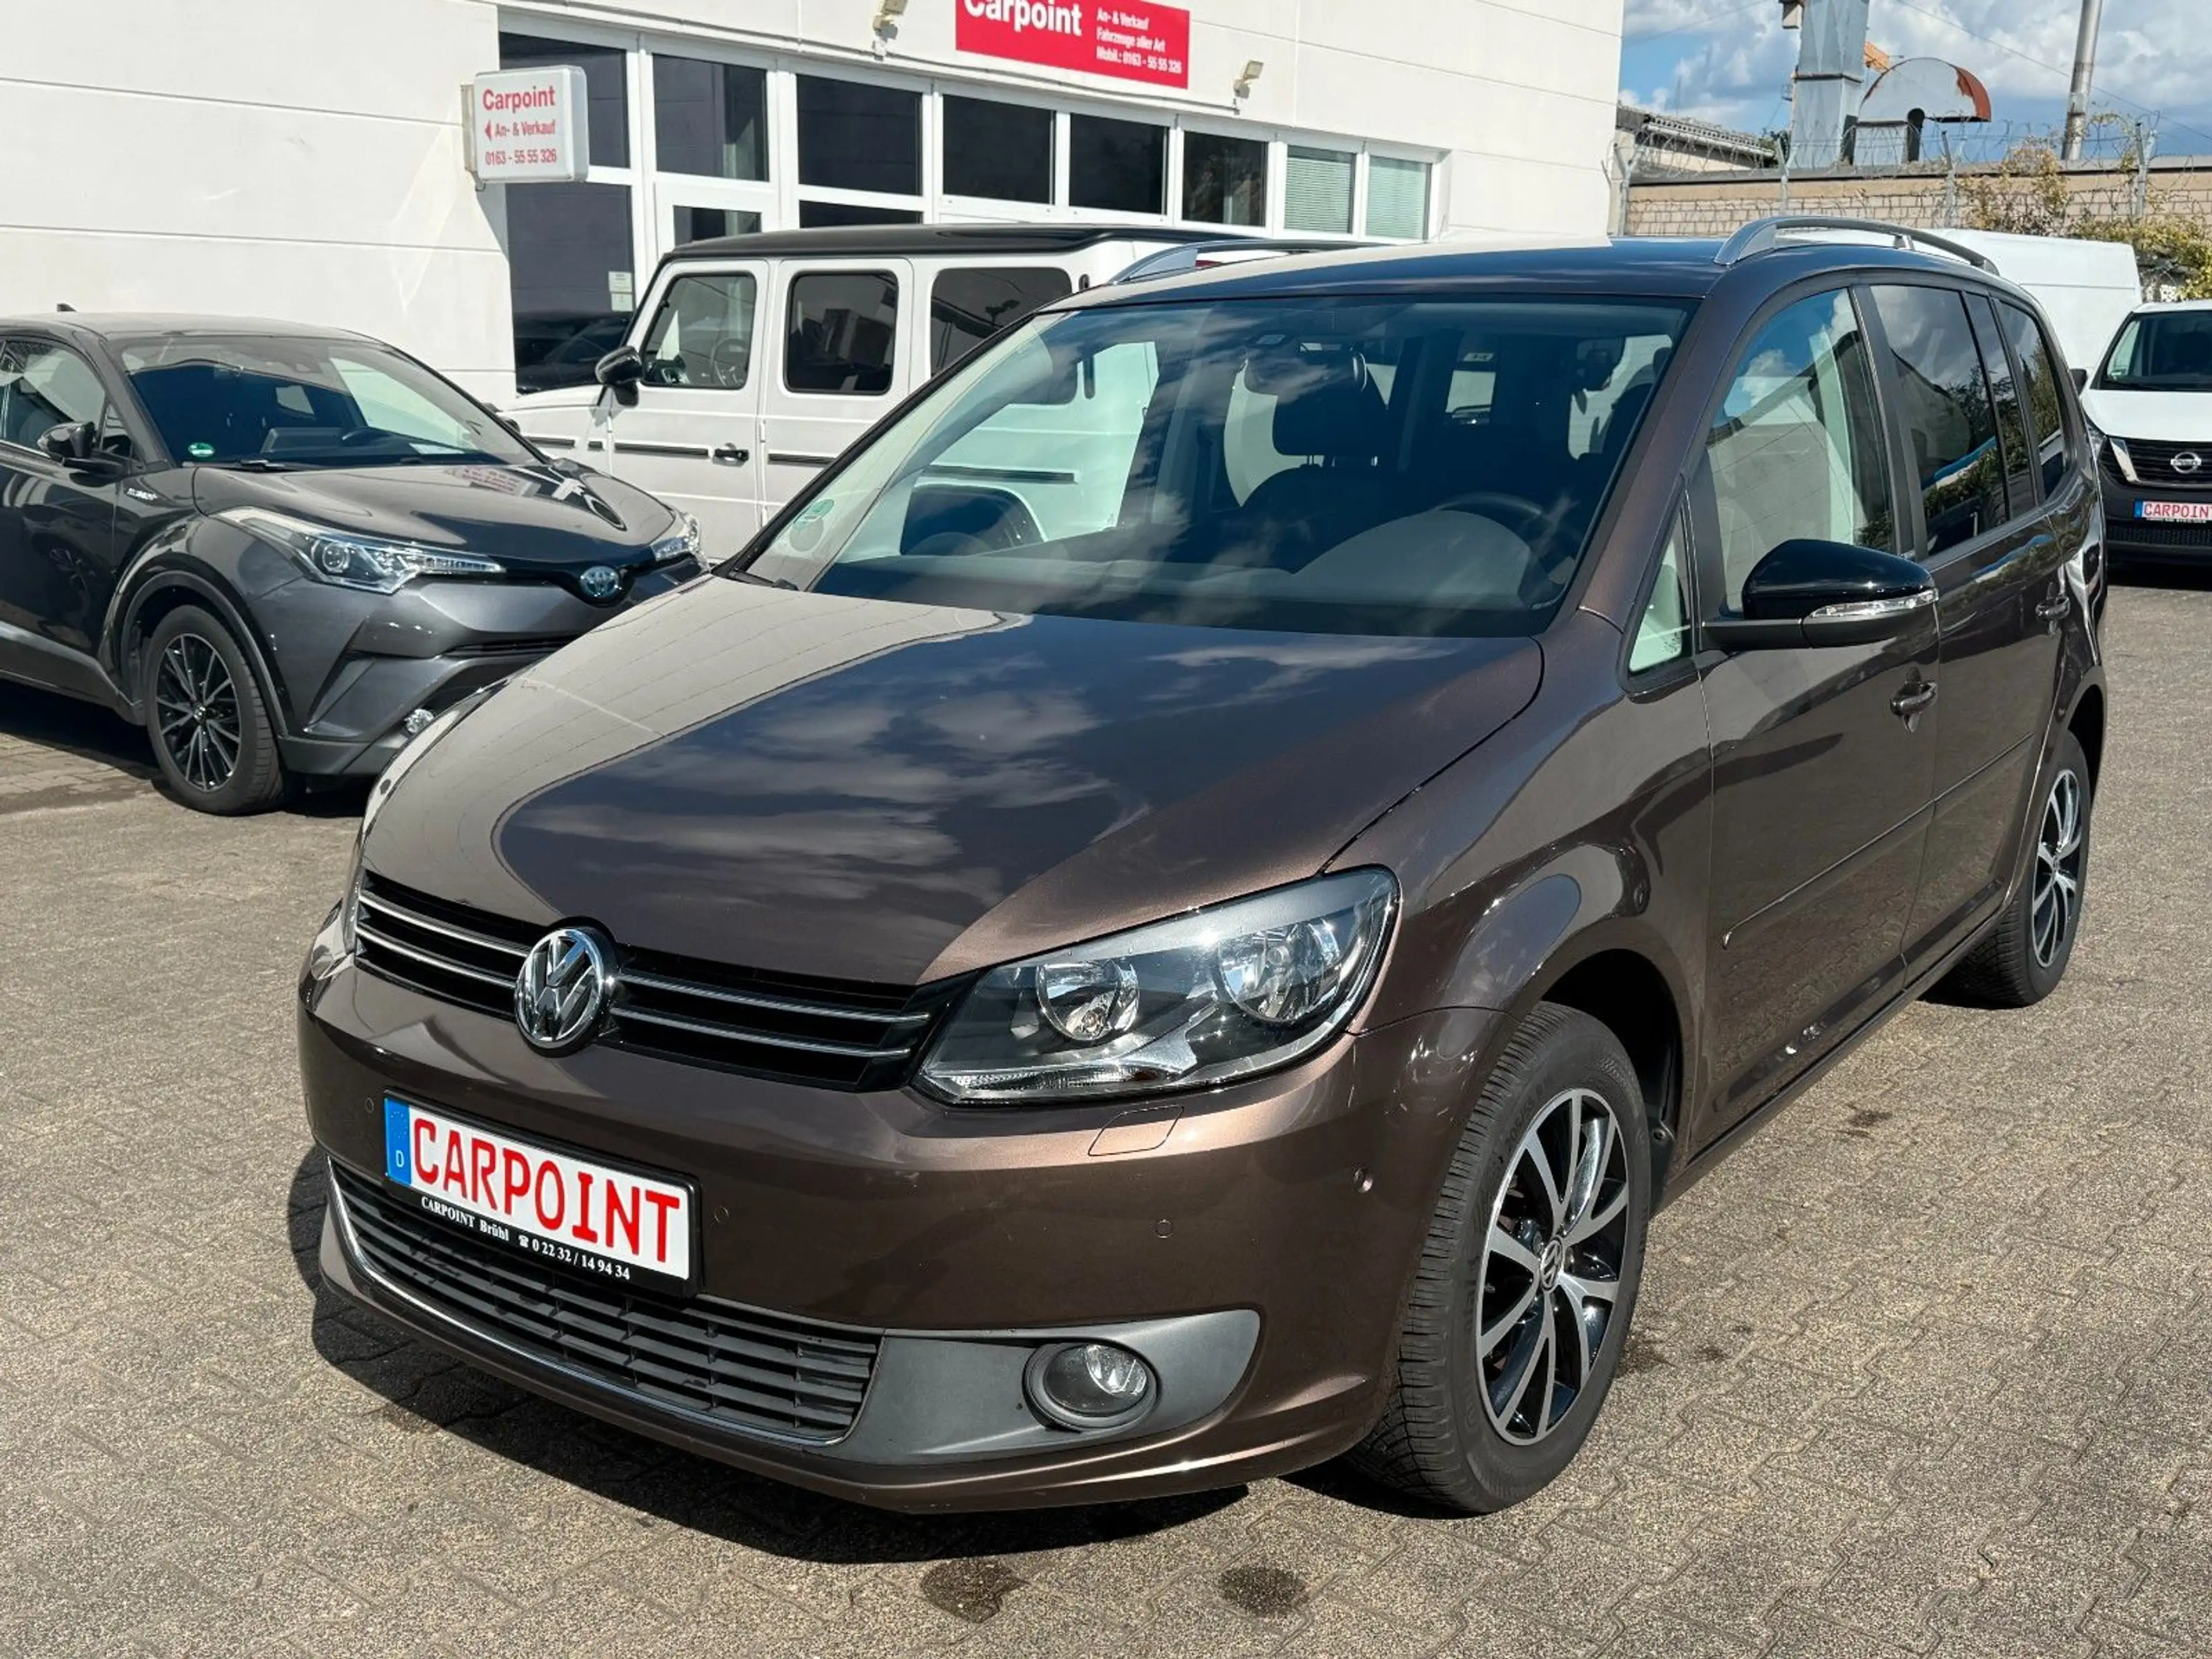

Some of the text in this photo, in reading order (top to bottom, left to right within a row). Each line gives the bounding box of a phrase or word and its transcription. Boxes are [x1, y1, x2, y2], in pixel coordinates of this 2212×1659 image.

[1120, 12, 1150, 31] Verkauf
[1096, 26, 1165, 53] Fahrzeuge aller Art
[1123, 50, 1141, 66] 0163
[482, 86, 556, 113] Carpoint
[495, 119, 556, 138] An- & Verkauf
[485, 150, 506, 165] 0163
[514, 150, 526, 164] 55
[527, 149, 539, 164] 55
[540, 148, 557, 163] 326
[2144, 503, 2212, 518] CARPOIN
[395, 1150, 404, 1168] D
[414, 1119, 680, 1263] CARPOINT
[422, 1196, 475, 1228] CARPOINT
[479, 1219, 510, 1241] Brühl
[532, 1238, 540, 1251] 0
[542, 1242, 555, 1257] 22
[557, 1247, 572, 1262] 32
[581, 1255, 595, 1270] 14
[597, 1259, 612, 1275] 94
[615, 1264, 631, 1280] 34
